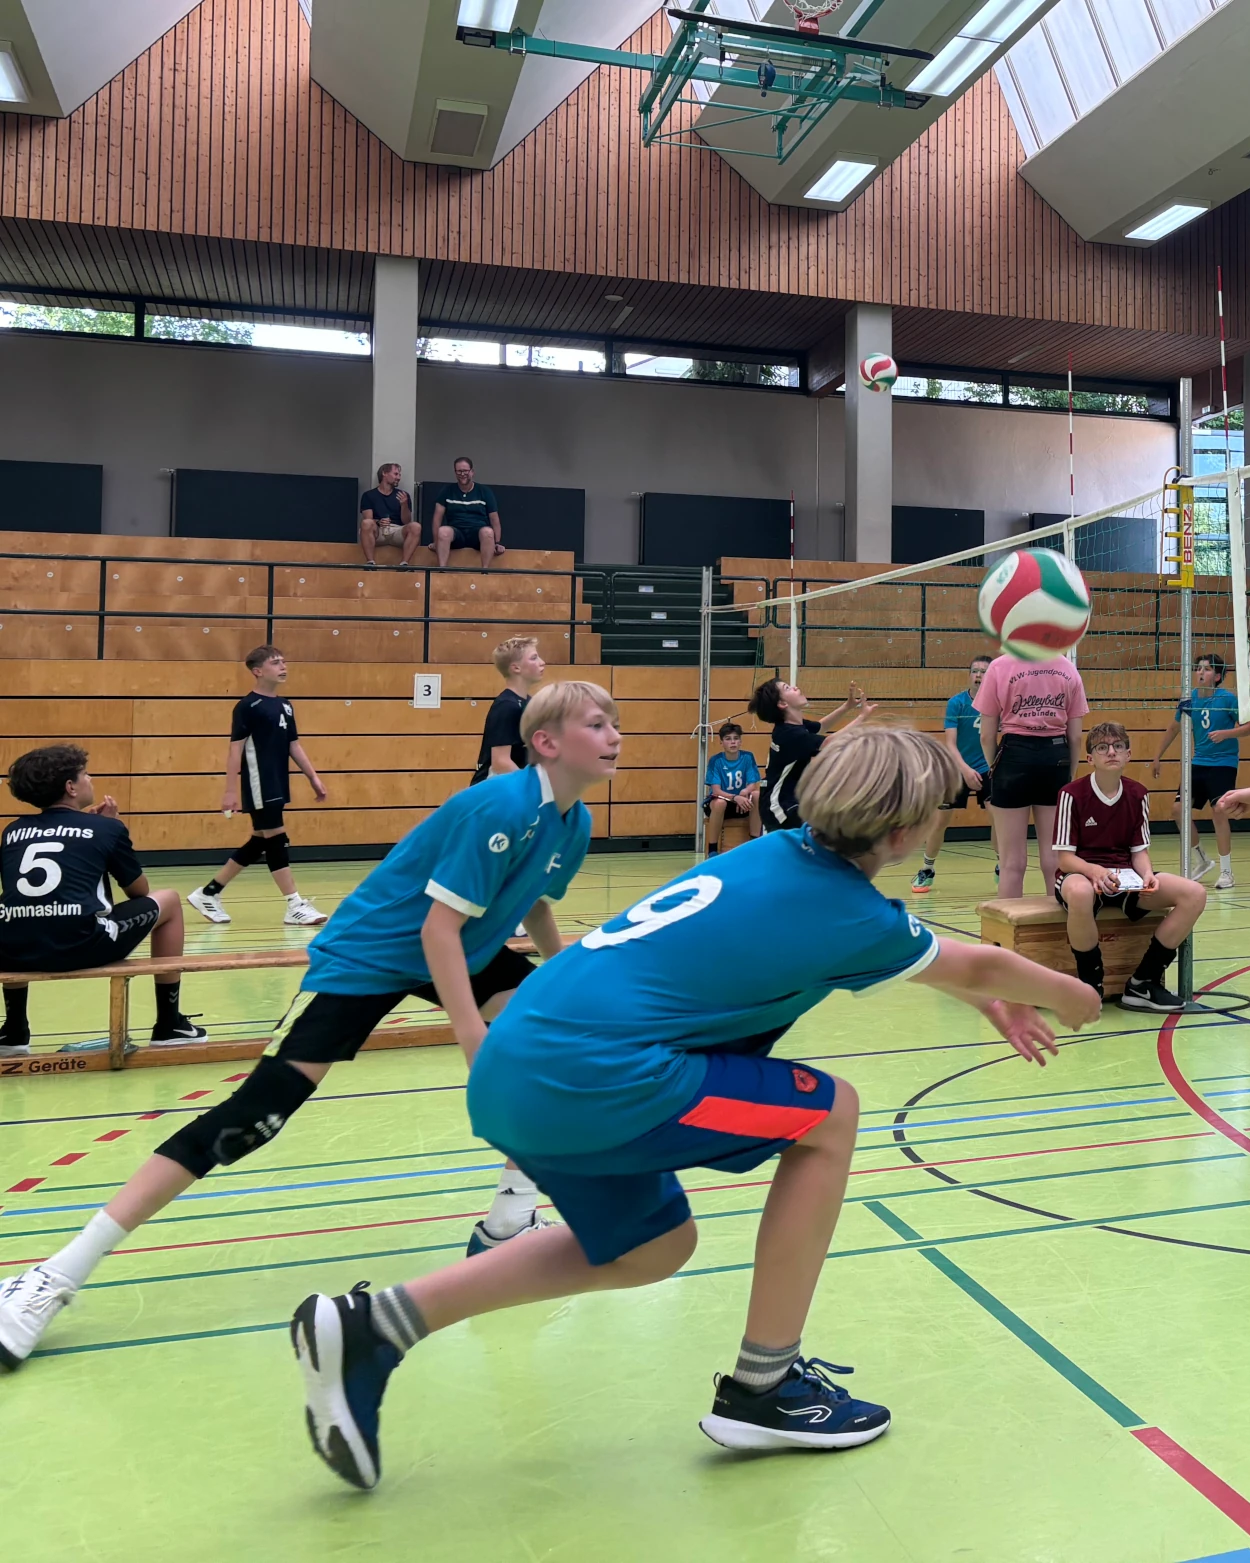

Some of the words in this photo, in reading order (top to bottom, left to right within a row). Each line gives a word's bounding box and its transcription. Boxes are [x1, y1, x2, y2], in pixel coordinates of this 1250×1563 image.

[1183, 509, 1192, 563] BENZ
[423, 684, 432, 697] 3
[278, 713, 288, 730] 4
[1019, 710, 1056, 718] verbindet
[1201, 709, 1211, 729] 3
[726, 771, 743, 790] 18
[6, 825, 94, 845] Wilhelms
[16, 841, 65, 897] 5
[0, 901, 82, 922] Gymnasium
[581, 874, 723, 950] 9
[28, 1058, 87, 1073] Geräte
